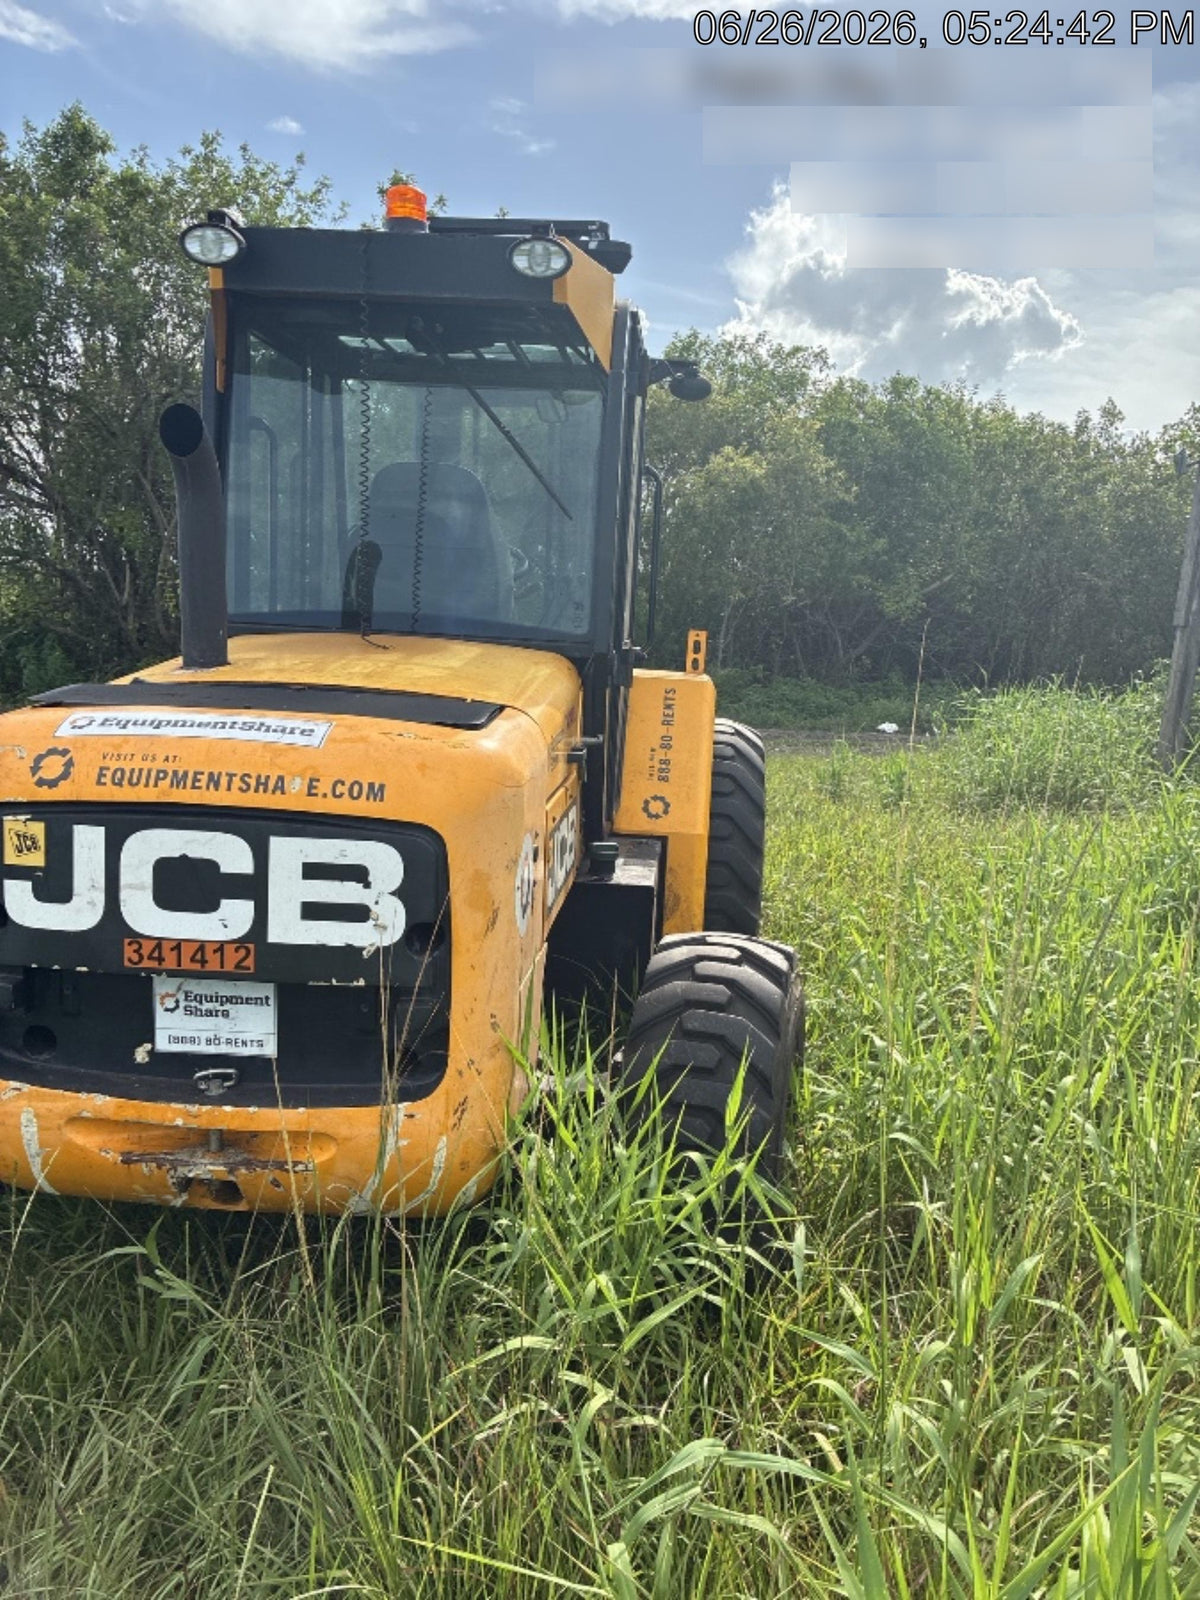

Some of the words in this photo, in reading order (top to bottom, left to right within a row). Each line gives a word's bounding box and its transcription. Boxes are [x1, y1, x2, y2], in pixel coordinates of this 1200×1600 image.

[99, 716, 316, 738] EquipmentShare
[657, 687, 676, 783] 888-80-RENTS
[101, 752, 136, 762] VISIT
[141, 753, 157, 763] US
[163, 754, 182, 764] AT:
[95, 766, 386, 802] EQUIPMENTSHAE.COM
[14, 833, 38, 853] JCB
[3, 824, 406, 947] JCB
[127, 939, 252, 971] 341412
[183, 990, 271, 1007] Equipment
[183, 1004, 230, 1019] Share
[205, 1035, 264, 1048] 80-RENTS
